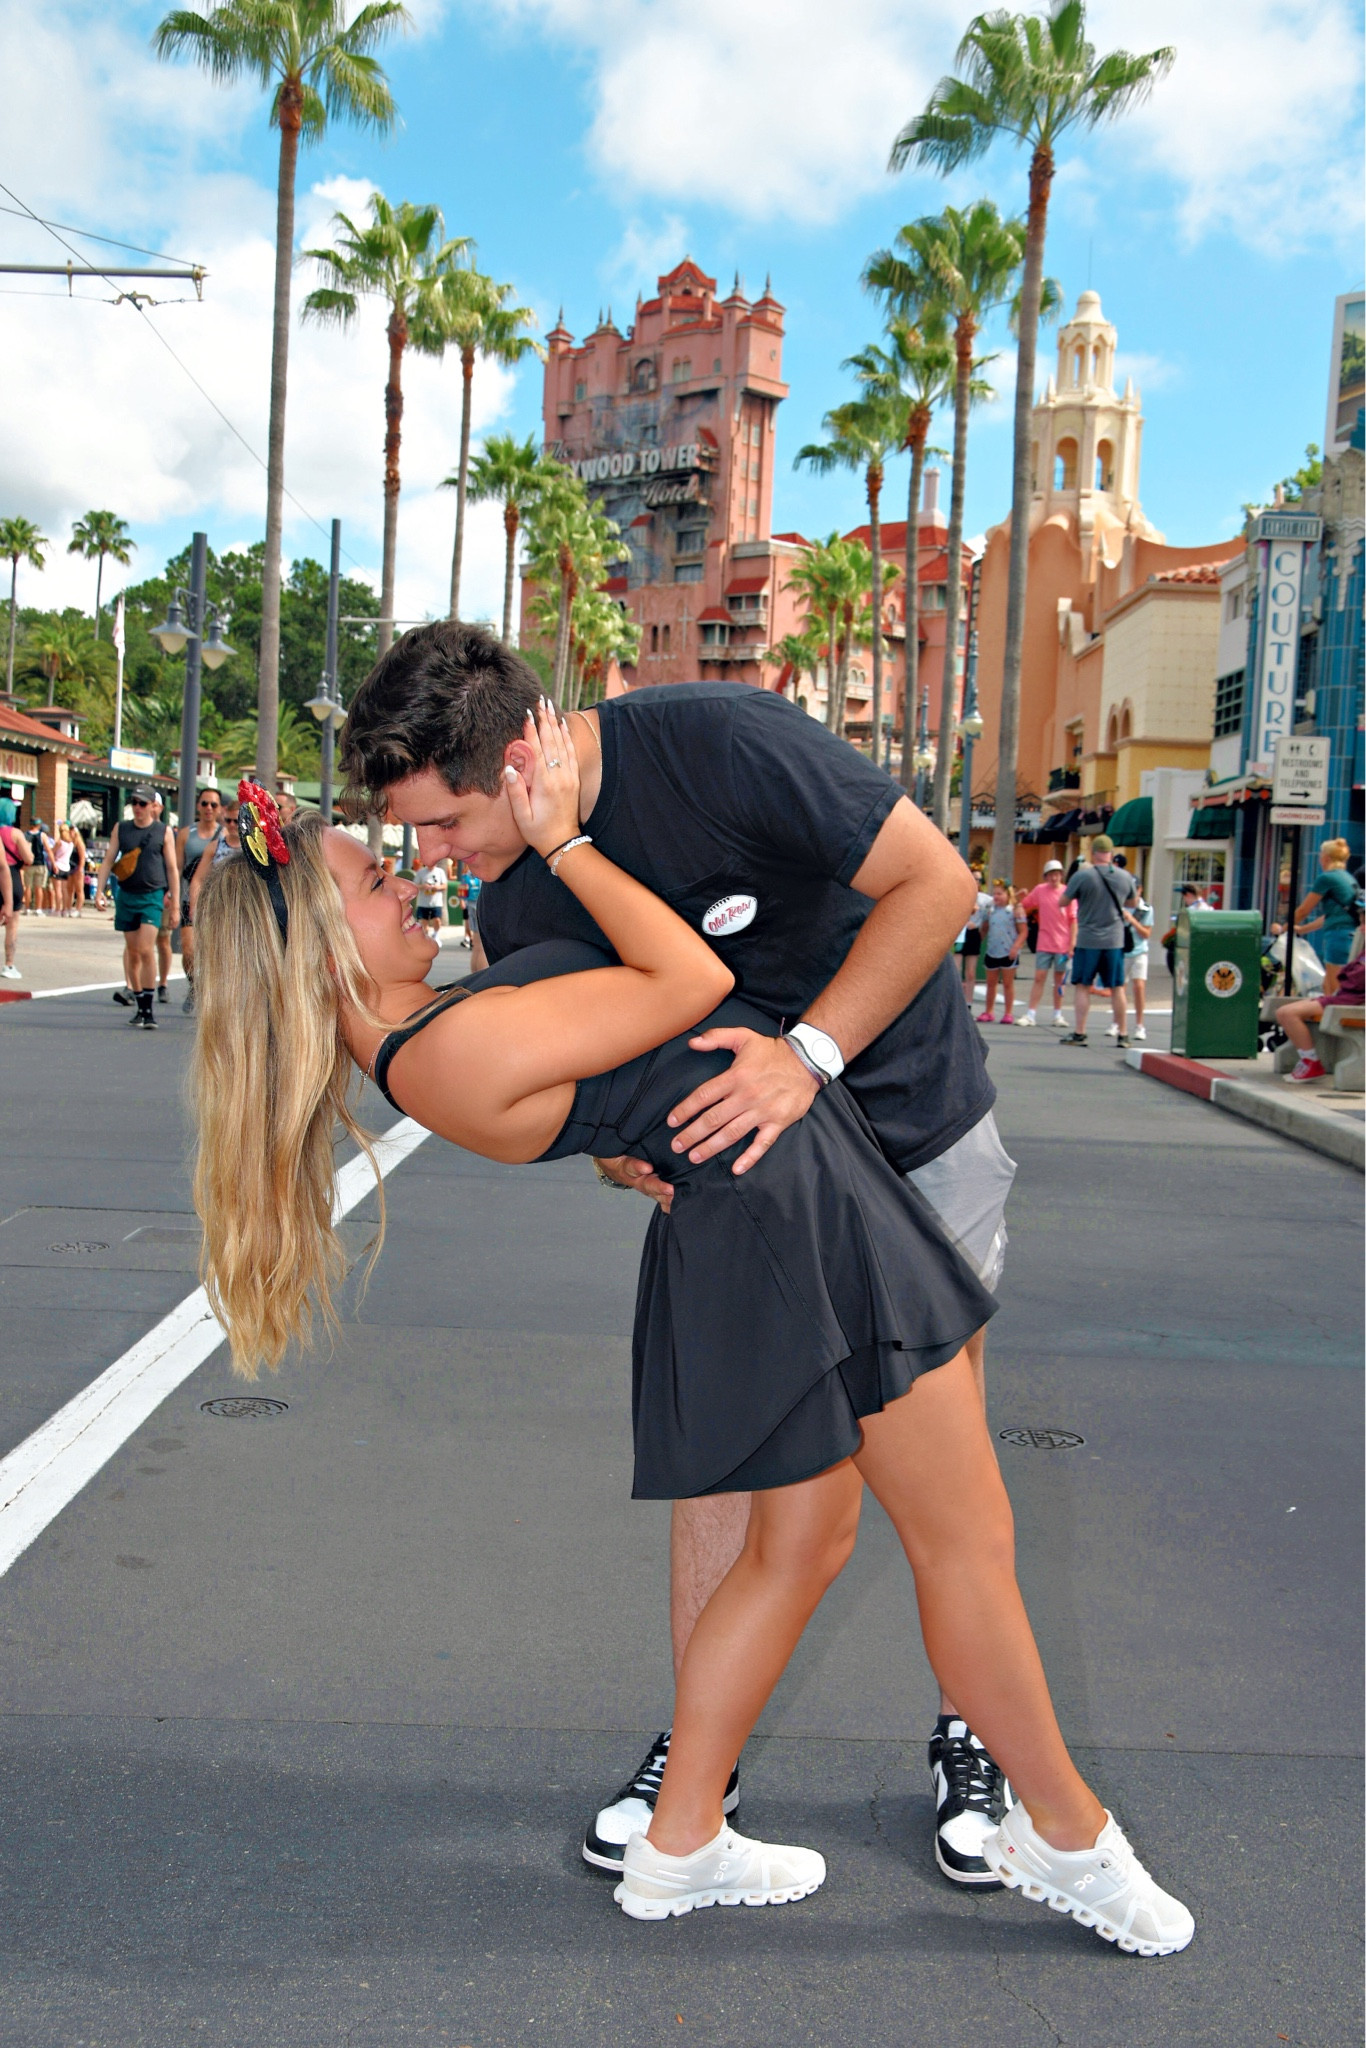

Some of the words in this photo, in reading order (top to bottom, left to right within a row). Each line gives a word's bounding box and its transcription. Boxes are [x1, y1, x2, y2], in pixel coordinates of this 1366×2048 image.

[640, 444, 699, 473] TOWER
[643, 474, 698, 506] Hotel
[1264, 551, 1297, 753] COUTURE
[1282, 759, 1323, 769] RESTROOMS
[1295, 769, 1309, 778] AND
[1280, 779, 1322, 789] TELEPHONES
